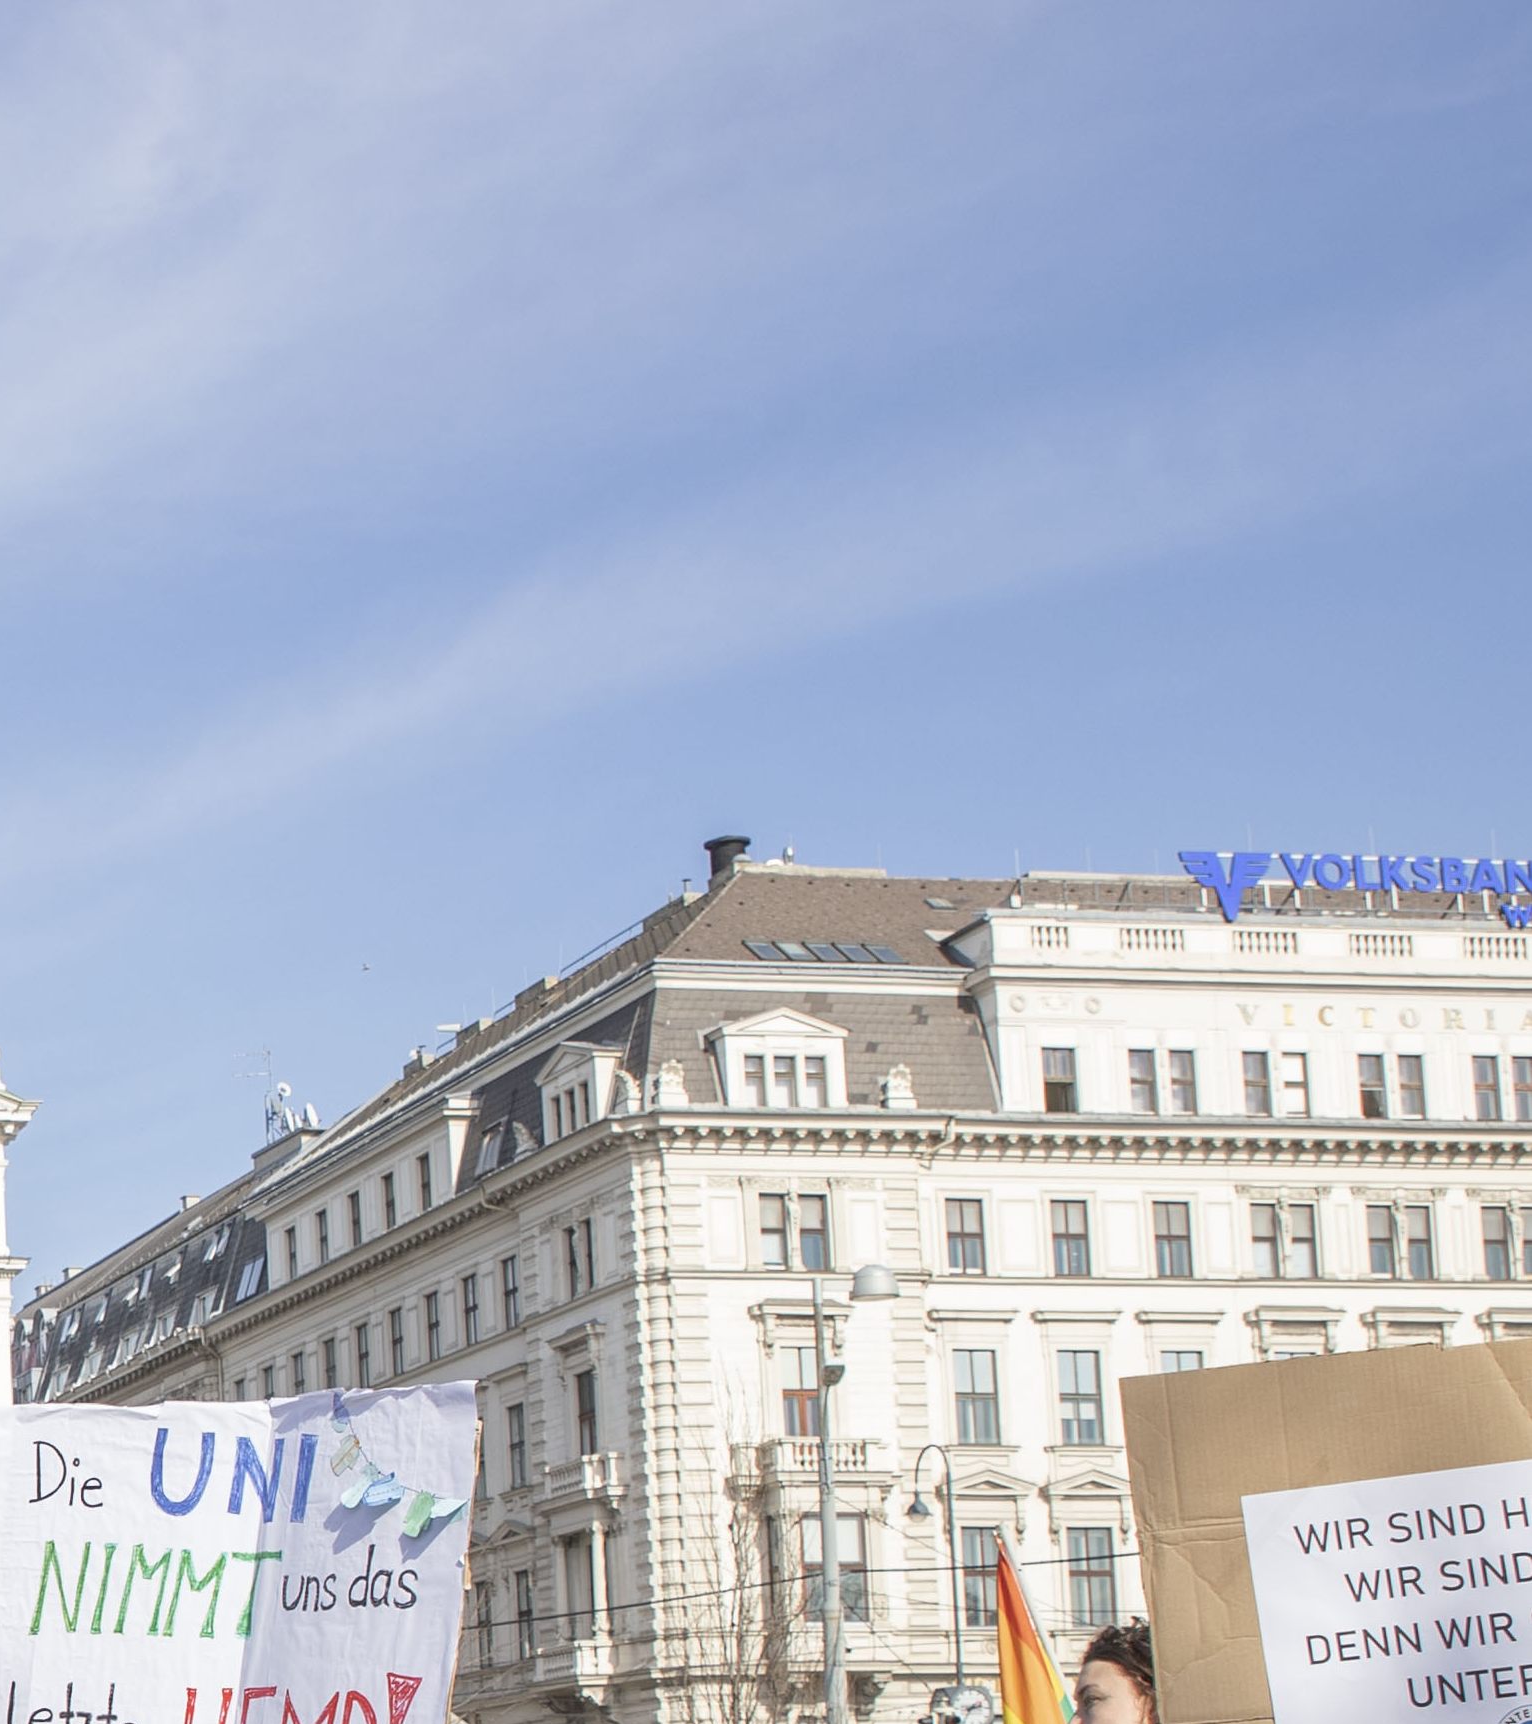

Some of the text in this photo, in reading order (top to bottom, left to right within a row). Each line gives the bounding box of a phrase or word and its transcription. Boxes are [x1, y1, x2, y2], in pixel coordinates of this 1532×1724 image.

[29, 1427, 319, 1524] Die UNI
[1293, 1517, 1374, 1555] WIR
[1388, 1503, 1486, 1544] SIND
[28, 1539, 418, 1639] NIMMT uns das
[1344, 1551, 1532, 1603] WIR SIND
[1305, 1612, 1517, 1666] DENN WIR
